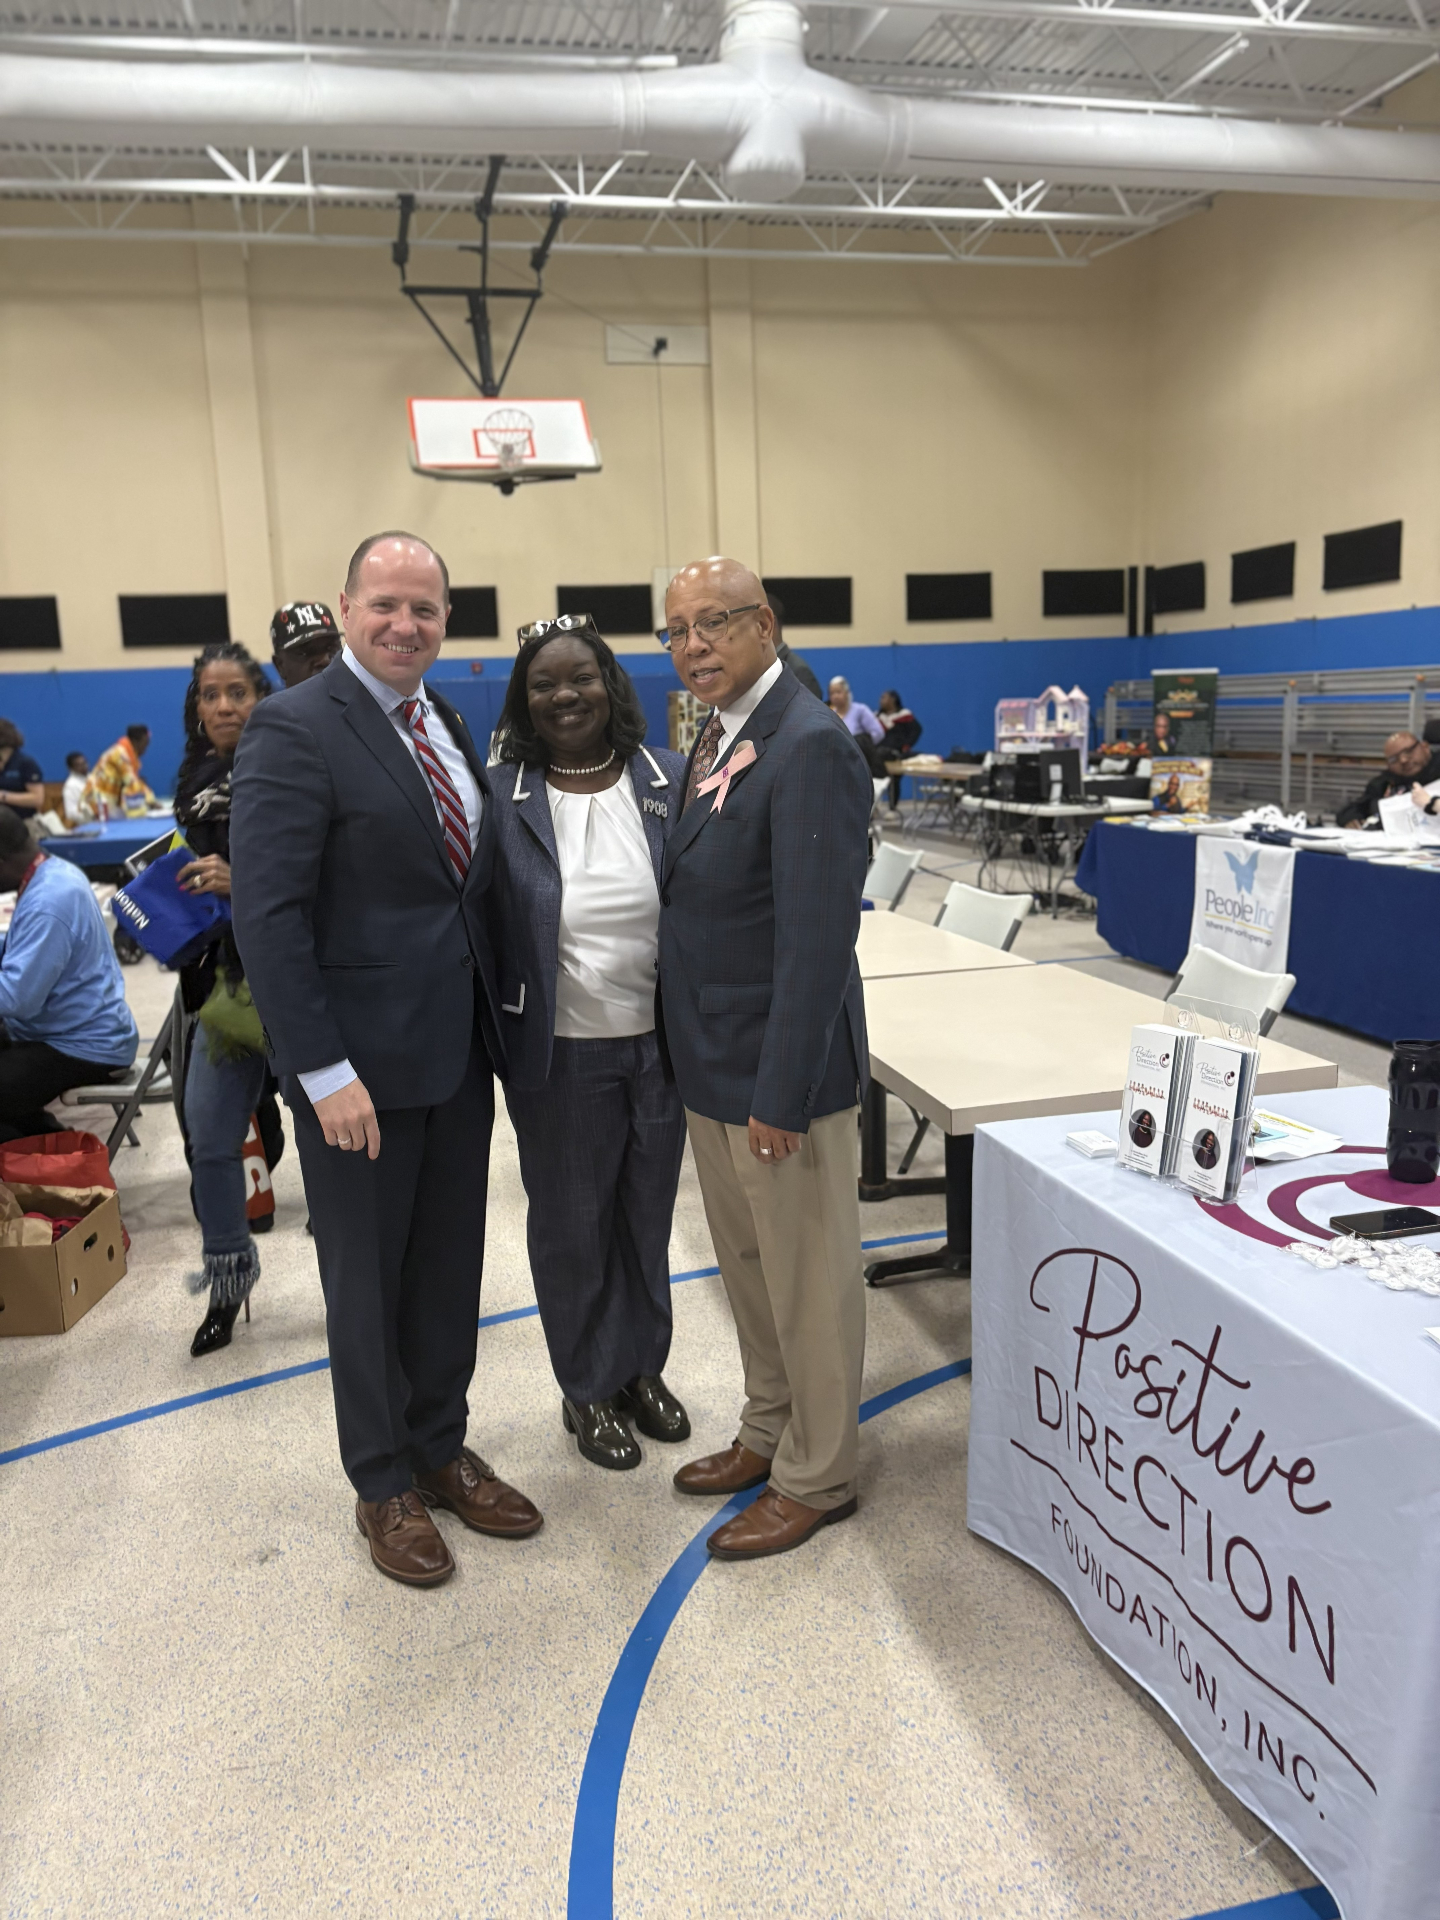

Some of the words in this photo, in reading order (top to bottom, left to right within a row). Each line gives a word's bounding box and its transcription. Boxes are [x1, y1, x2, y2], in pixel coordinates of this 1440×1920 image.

[642, 796, 668, 818] 1908
[1204, 888, 1254, 923] People
[1030, 1249, 1330, 1514] Positive
[1035, 1366, 1335, 1685] DIRECTION
[1050, 1503, 1229, 1732] FOUNDATION,
[1243, 1710, 1326, 1820] INC.
